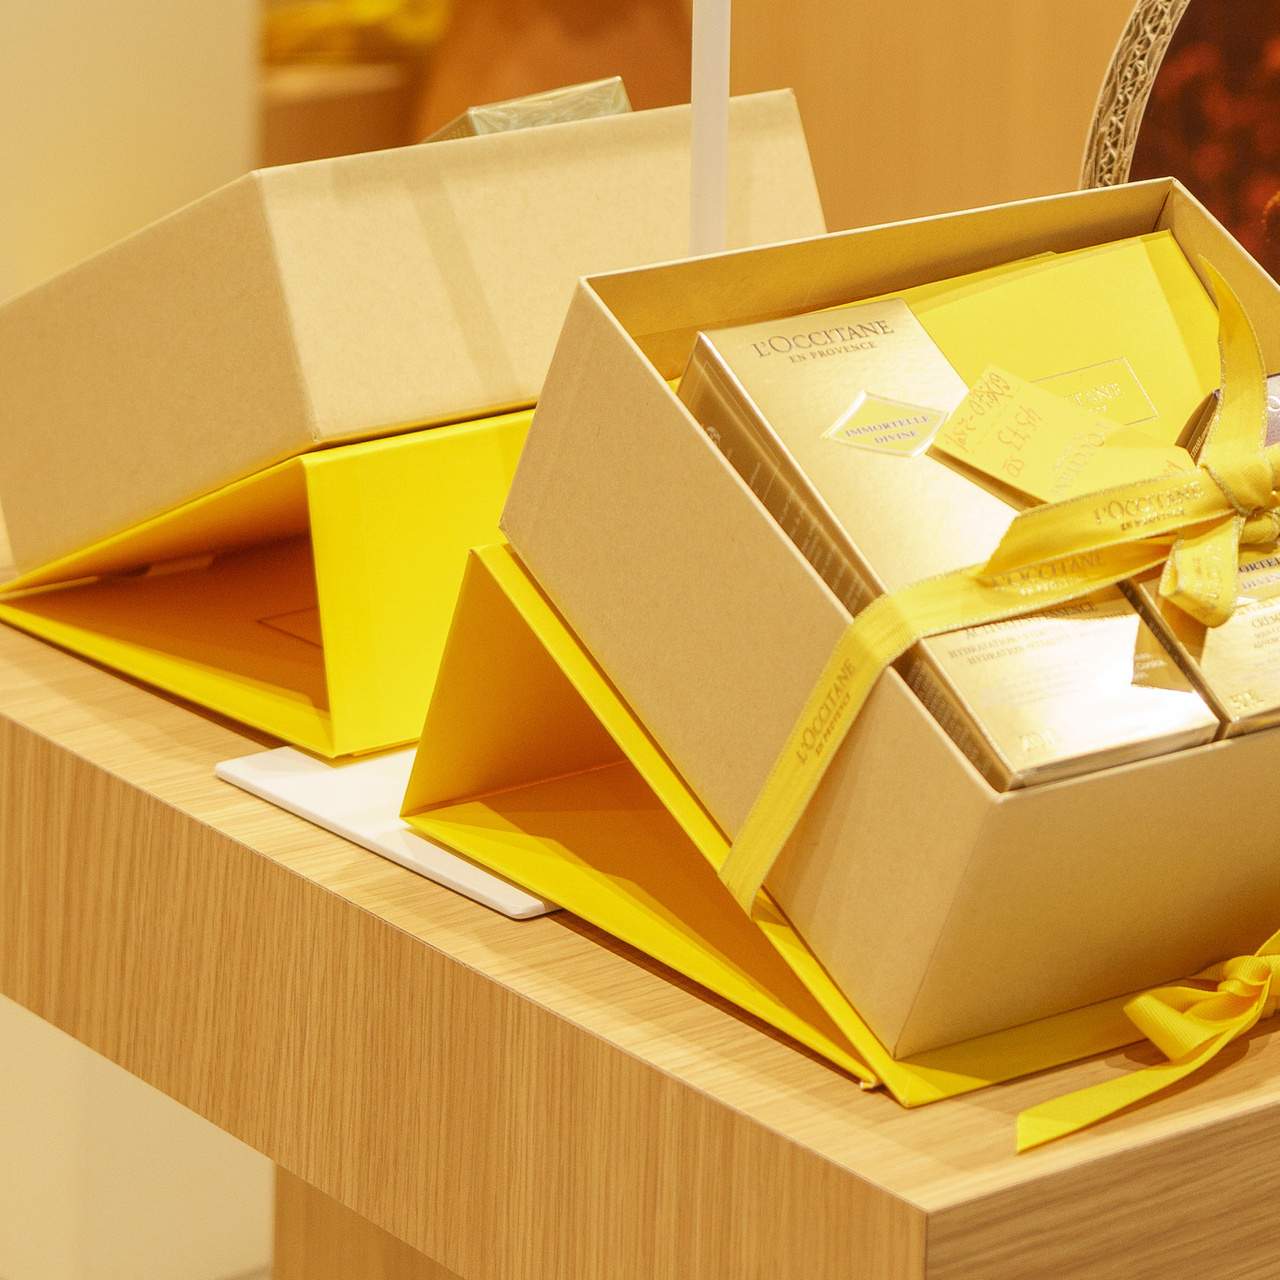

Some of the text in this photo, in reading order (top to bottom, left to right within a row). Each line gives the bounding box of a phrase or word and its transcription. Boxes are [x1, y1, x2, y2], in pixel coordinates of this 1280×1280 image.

[752, 319, 895, 358] L'OCCITANE
[789, 340, 878, 364] EN PROVENCE
[844, 413, 932, 438] IMMORTELLE
[873, 428, 920, 445] DIVINE
[796, 658, 856, 765] L'OCCITANE
